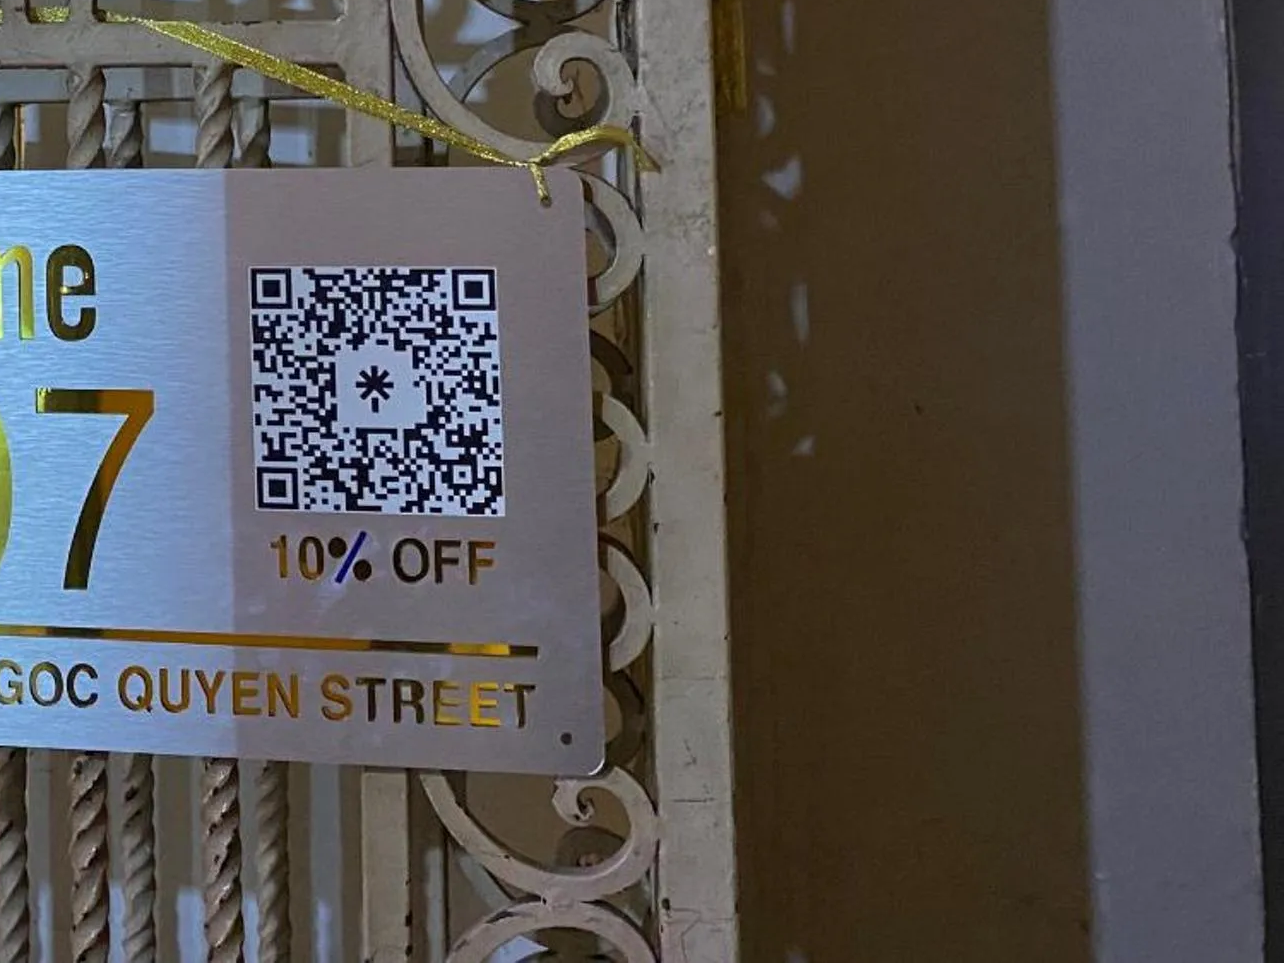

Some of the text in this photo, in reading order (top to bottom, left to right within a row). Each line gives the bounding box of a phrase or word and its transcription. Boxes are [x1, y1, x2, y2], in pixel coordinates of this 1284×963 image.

[269, 530, 497, 585] 10% OFF
[117, 664, 301, 721] QUYEN
[320, 672, 538, 730] STREET
